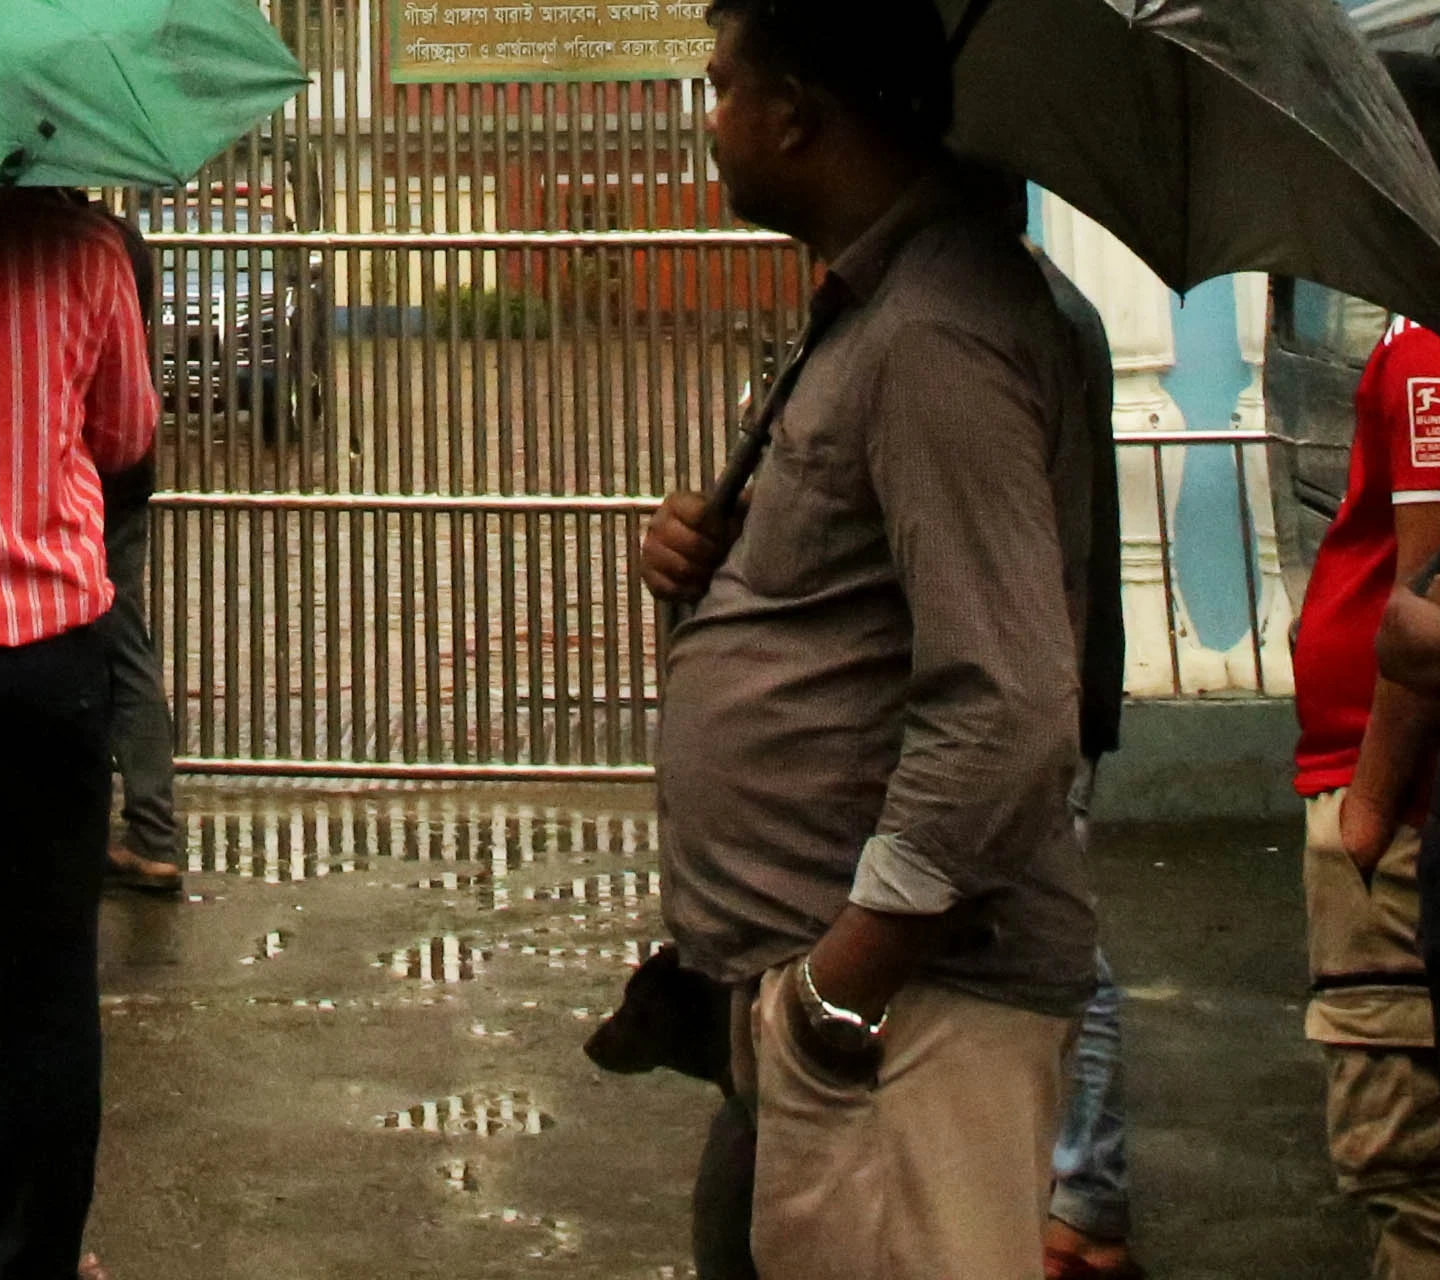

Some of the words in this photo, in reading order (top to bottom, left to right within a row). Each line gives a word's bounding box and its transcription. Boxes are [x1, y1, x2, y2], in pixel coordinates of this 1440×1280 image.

[404, 2, 438, 26] গীর্জা
[493, 3, 534, 23] যারাই
[539, 5, 602, 26] আসবেন,
[480, 43, 490, 59] ও
[563, 35, 617, 58] পরিবেশ
